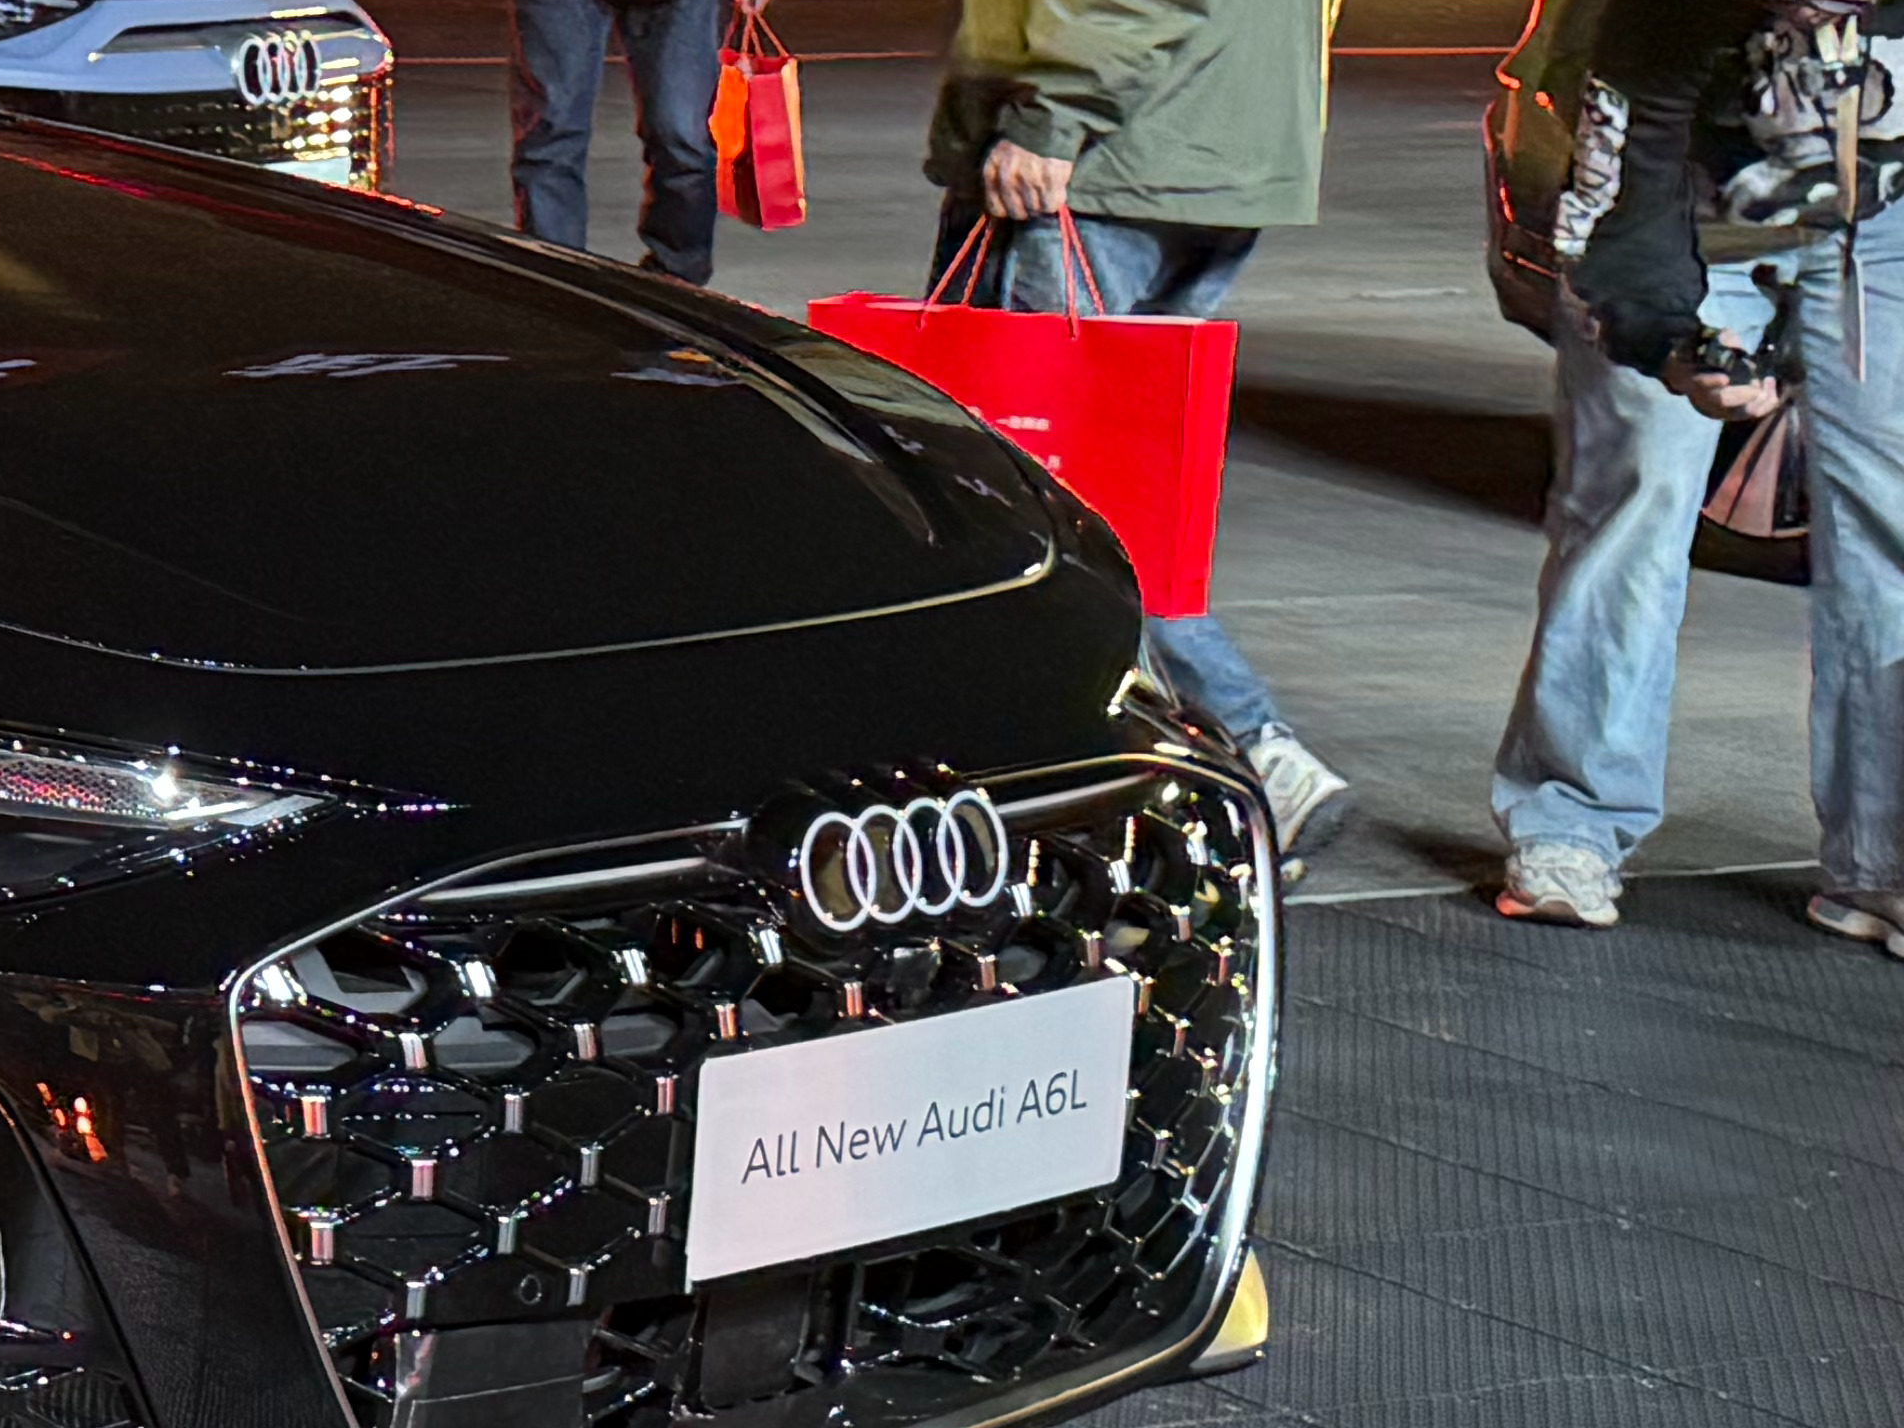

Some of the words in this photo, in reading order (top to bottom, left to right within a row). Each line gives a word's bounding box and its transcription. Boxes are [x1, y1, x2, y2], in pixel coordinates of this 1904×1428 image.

[740, 1129, 801, 1185] All
[815, 1118, 908, 1169] New
[916, 1085, 1007, 1148] Audi
[1015, 1068, 1089, 1125] A6L
